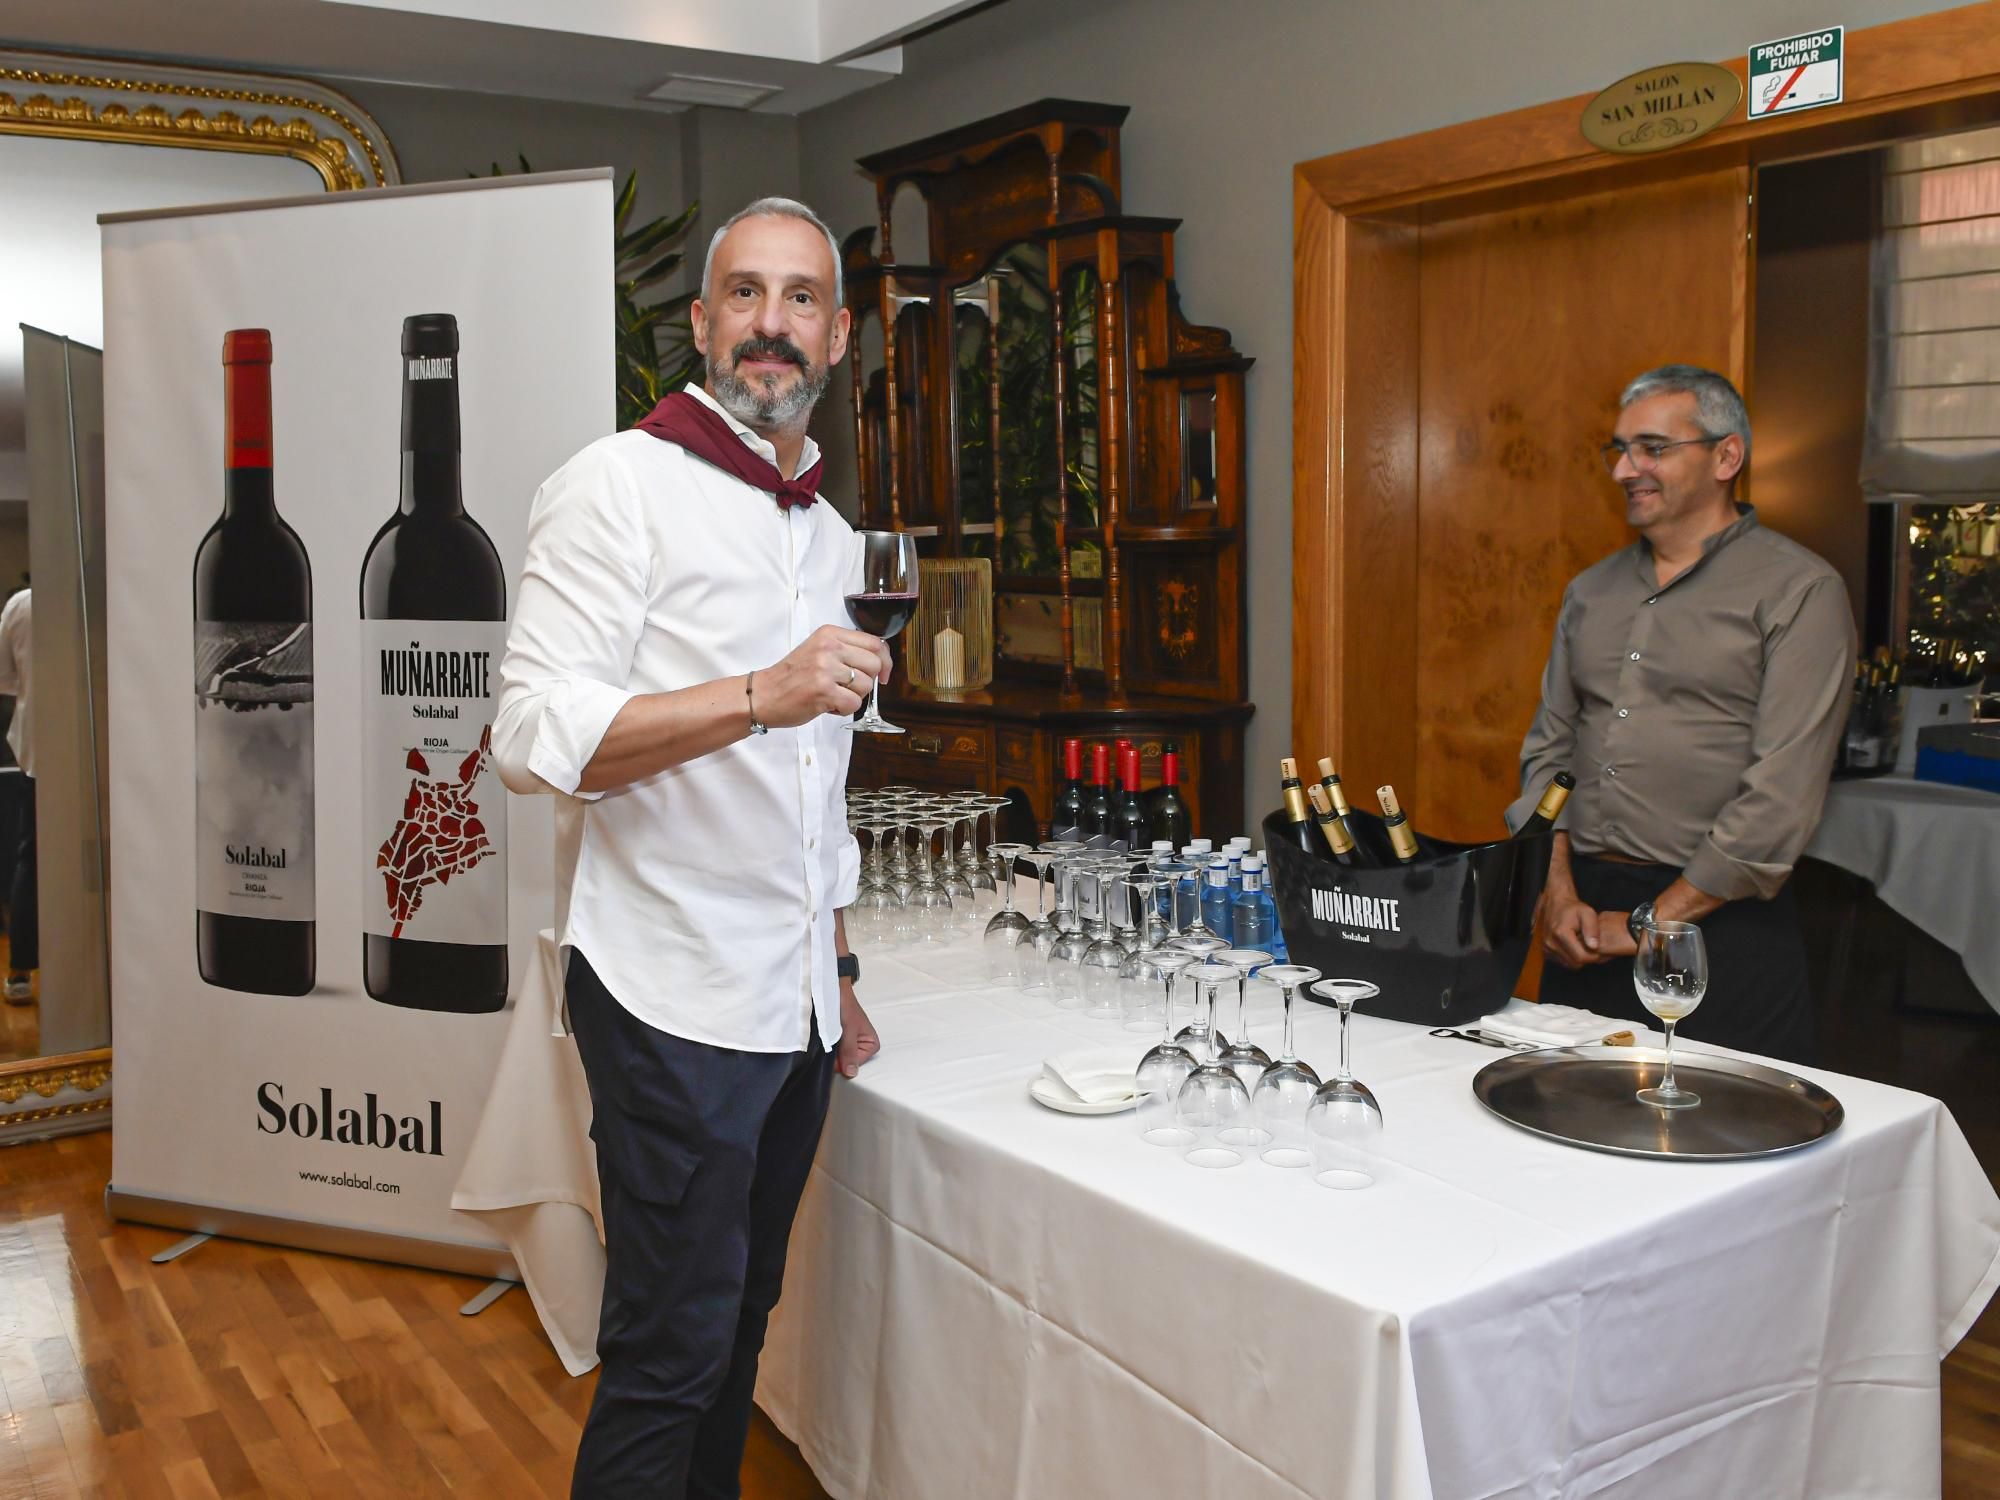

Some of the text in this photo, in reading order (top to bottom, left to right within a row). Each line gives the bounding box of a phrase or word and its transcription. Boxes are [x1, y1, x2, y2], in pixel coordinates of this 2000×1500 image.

[1757, 33, 1834, 61] PROHIBIDO
[1770, 50, 1819, 71] FUMAR
[1634, 72, 1680, 95] SALÓN
[1601, 85, 1716, 125] SAN MILLÁN
[408, 355, 453, 381] MUÑARRATE
[381, 641, 491, 698] MUÑARRATE
[412, 704, 459, 720] Solabal
[423, 737, 449, 748] RIOJA
[225, 844, 287, 869] Solabal
[245, 883, 266, 893] RIOJA
[1311, 886, 1401, 932] MUÑARRATE
[1341, 931, 1370, 943] Solabal
[257, 1081, 445, 1156] Solabal
[299, 1170, 401, 1195] www.solabal.com
